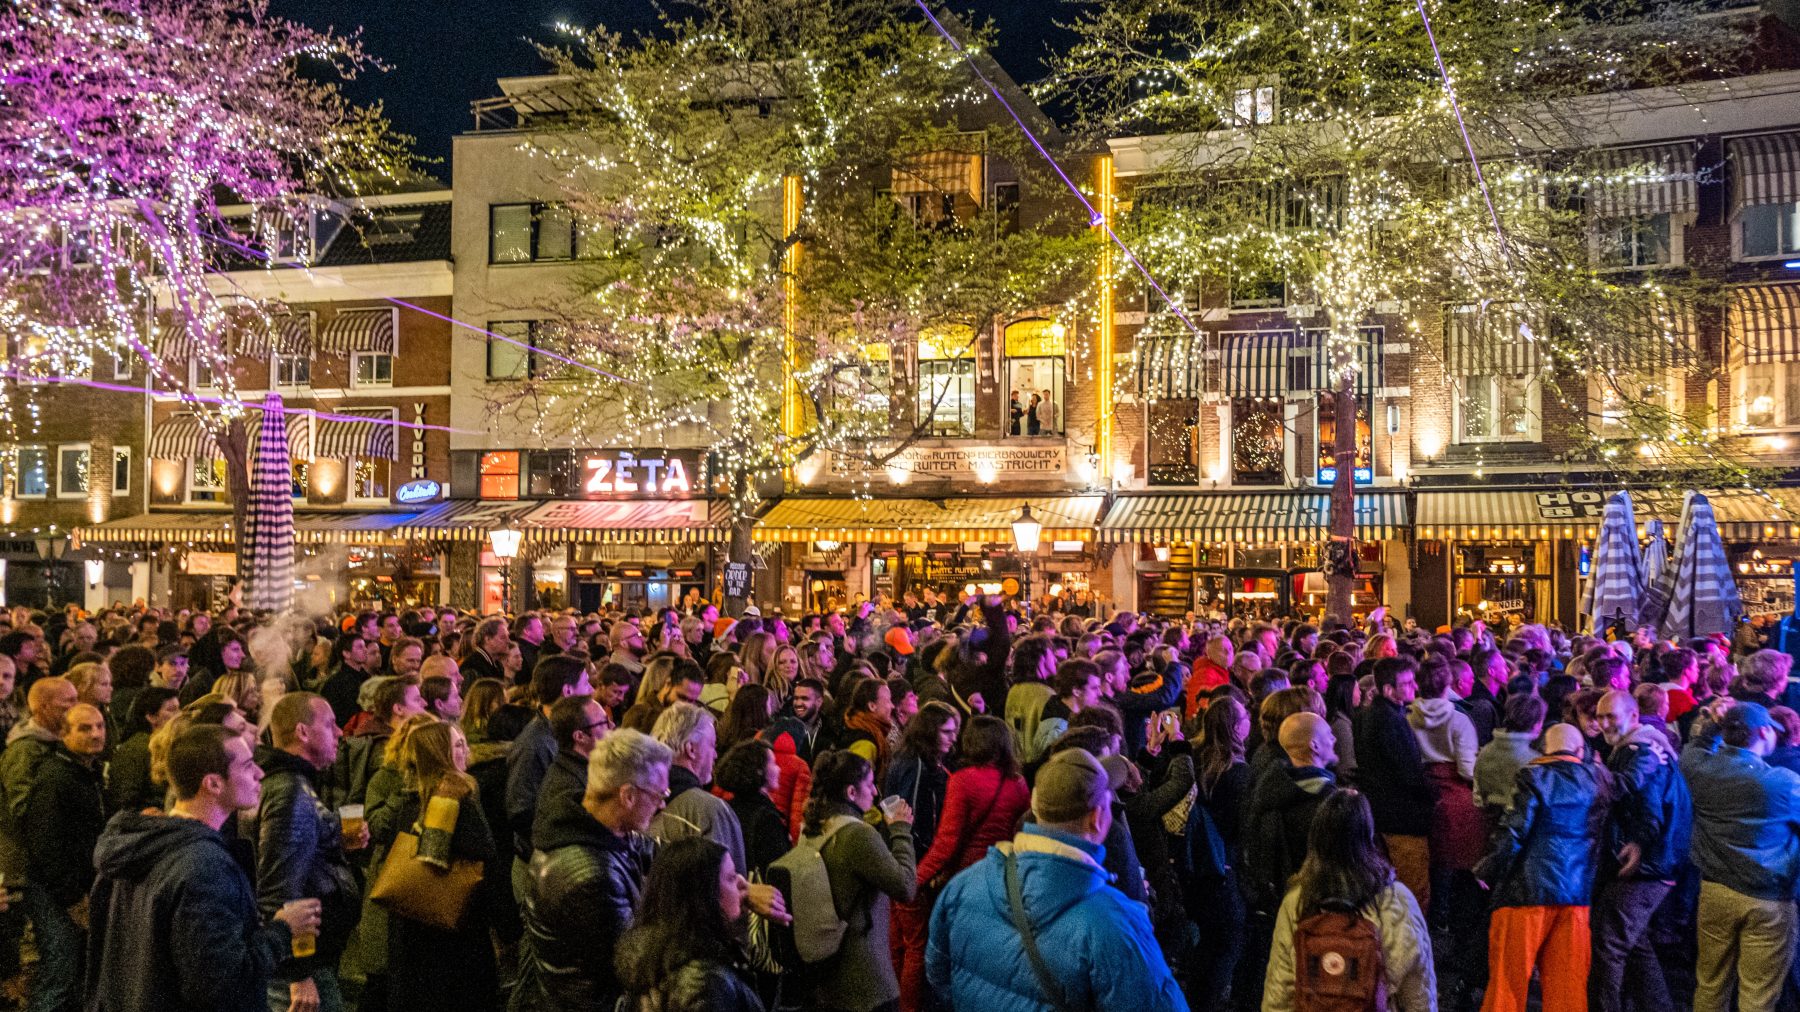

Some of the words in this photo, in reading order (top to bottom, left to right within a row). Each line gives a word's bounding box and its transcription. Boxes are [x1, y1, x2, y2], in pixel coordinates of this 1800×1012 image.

[411, 402, 425, 478] VAVOOM
[913, 461, 957, 471] RUITER
[968, 460, 1051, 470] MAASTRICHT
[1138, 506, 1375, 517] SEPTEMBR
[1541, 507, 1574, 517] EN
[726, 570, 748, 580] ORDER
